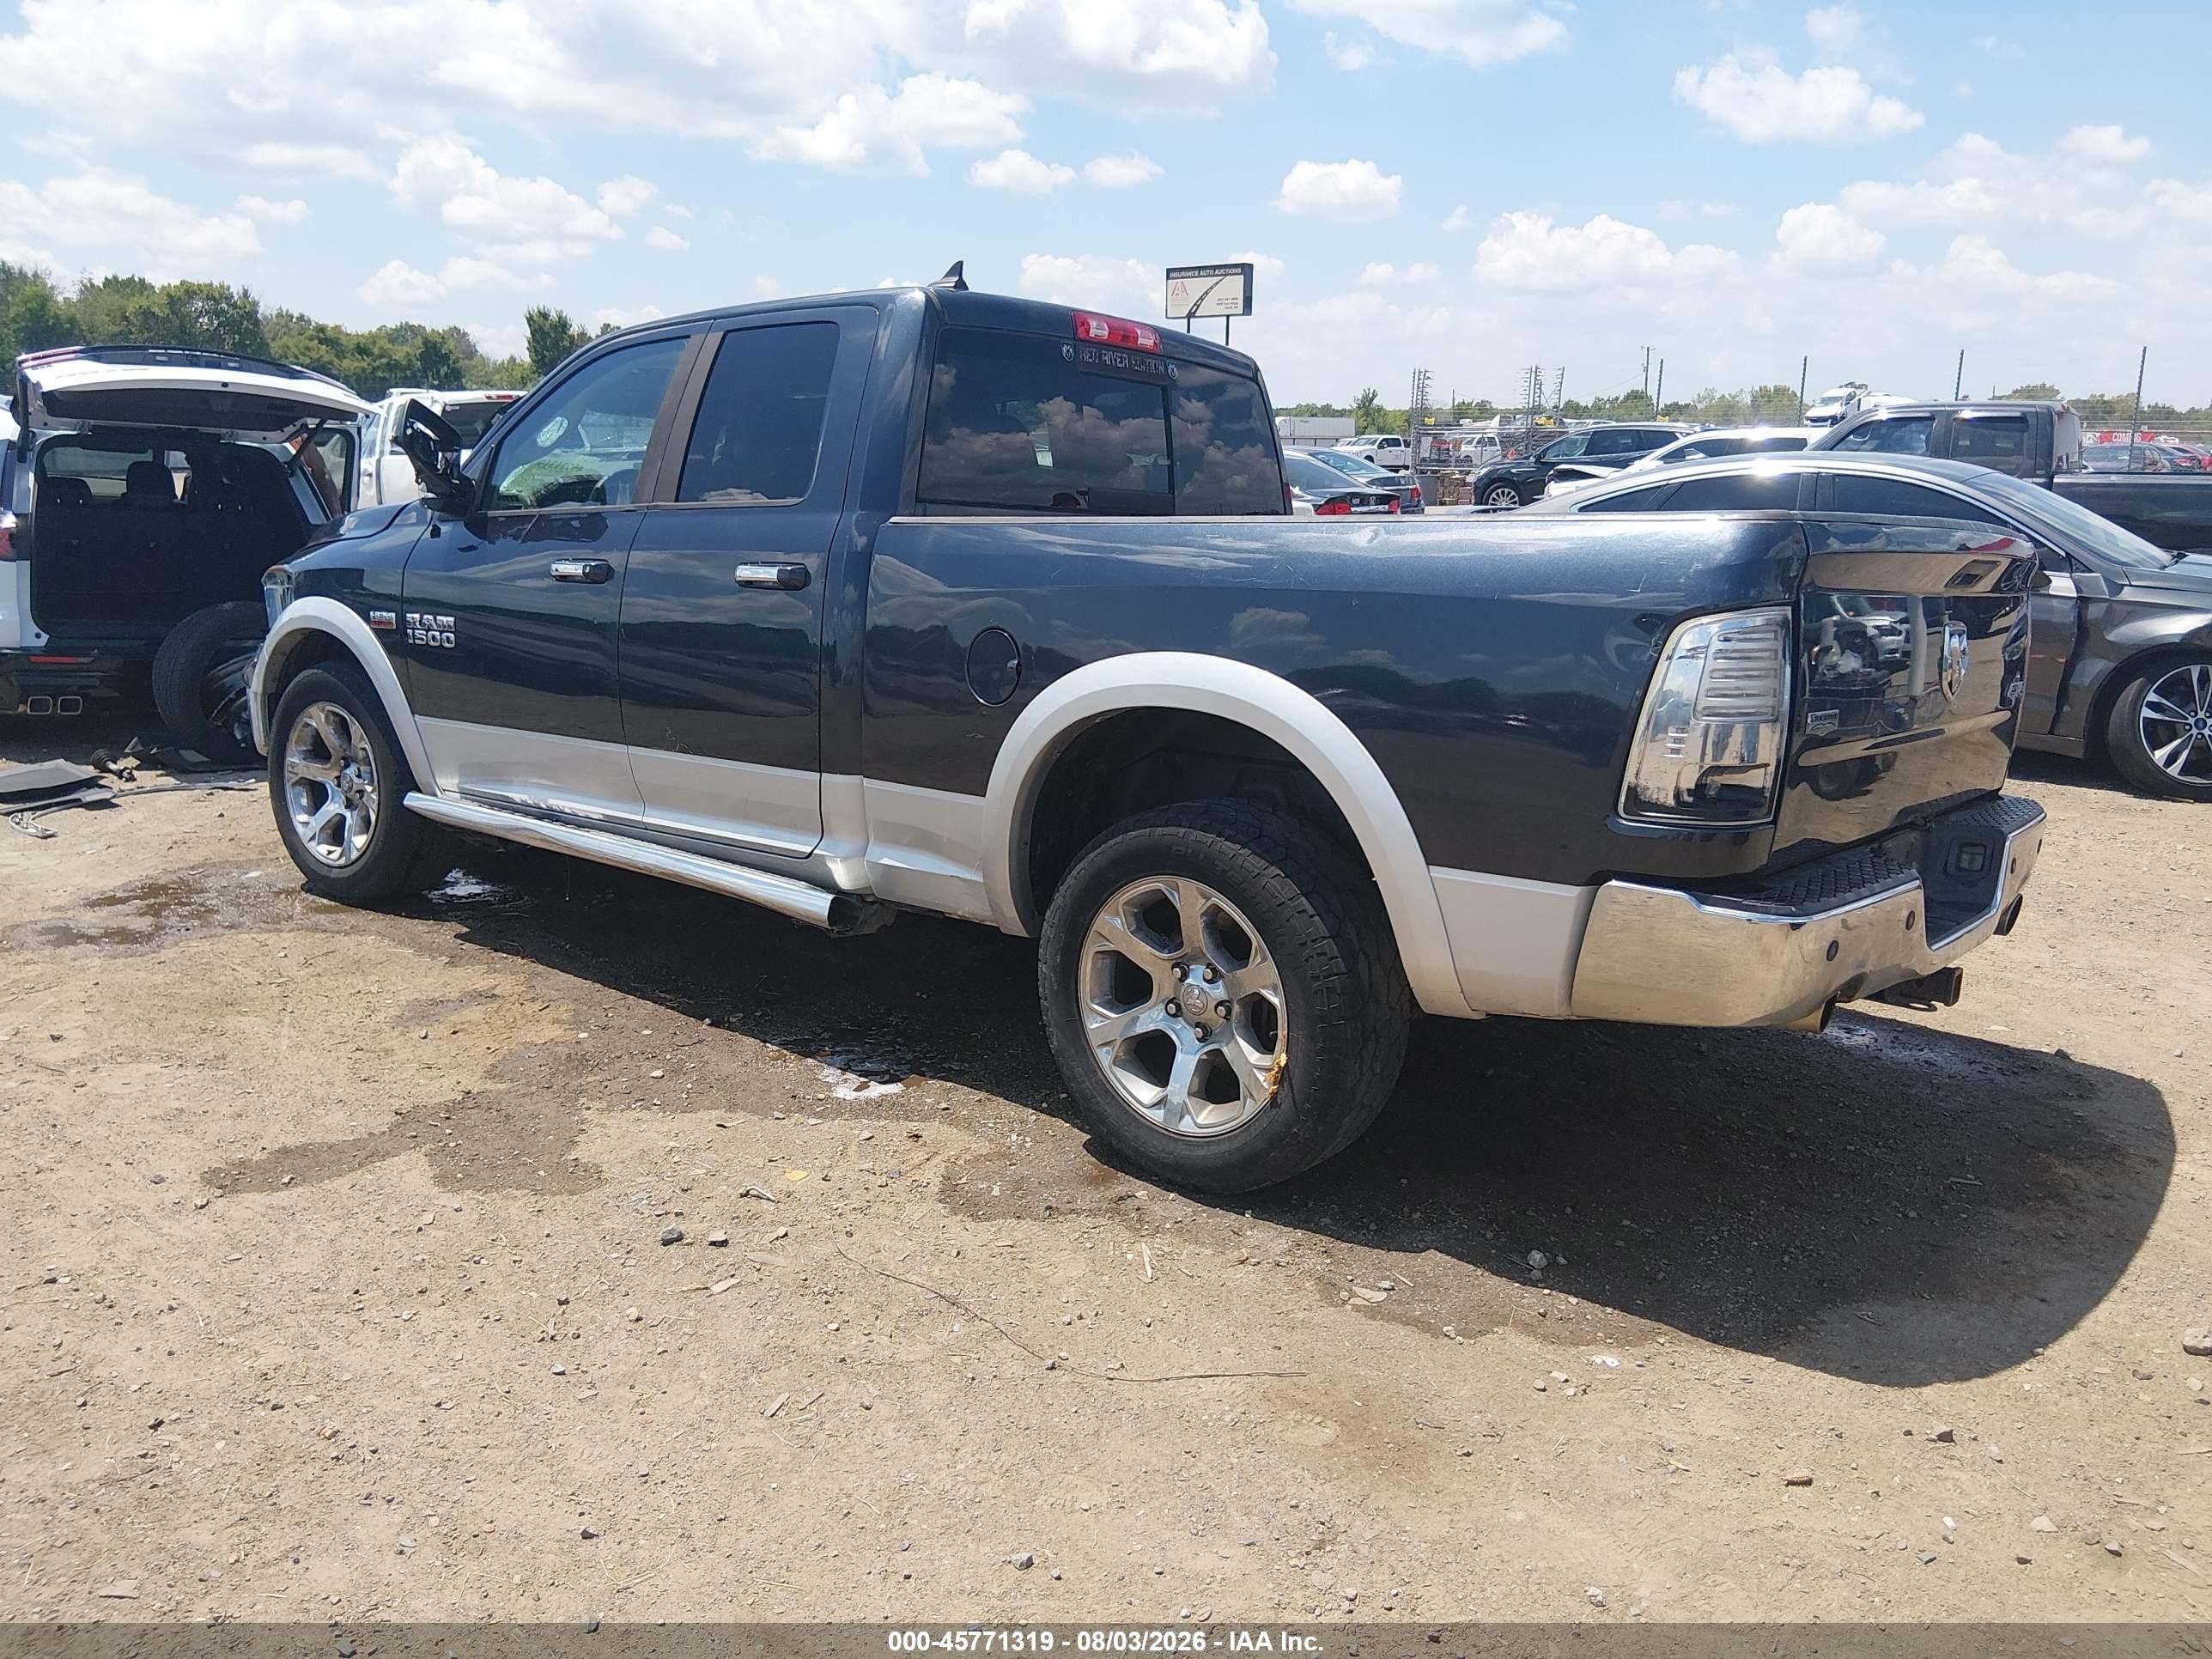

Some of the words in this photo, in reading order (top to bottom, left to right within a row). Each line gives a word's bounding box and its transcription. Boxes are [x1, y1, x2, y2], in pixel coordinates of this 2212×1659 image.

[1102, 349, 1128, 368] RIVER
[405, 613, 455, 631] RAM
[406, 629, 455, 648] 1500
